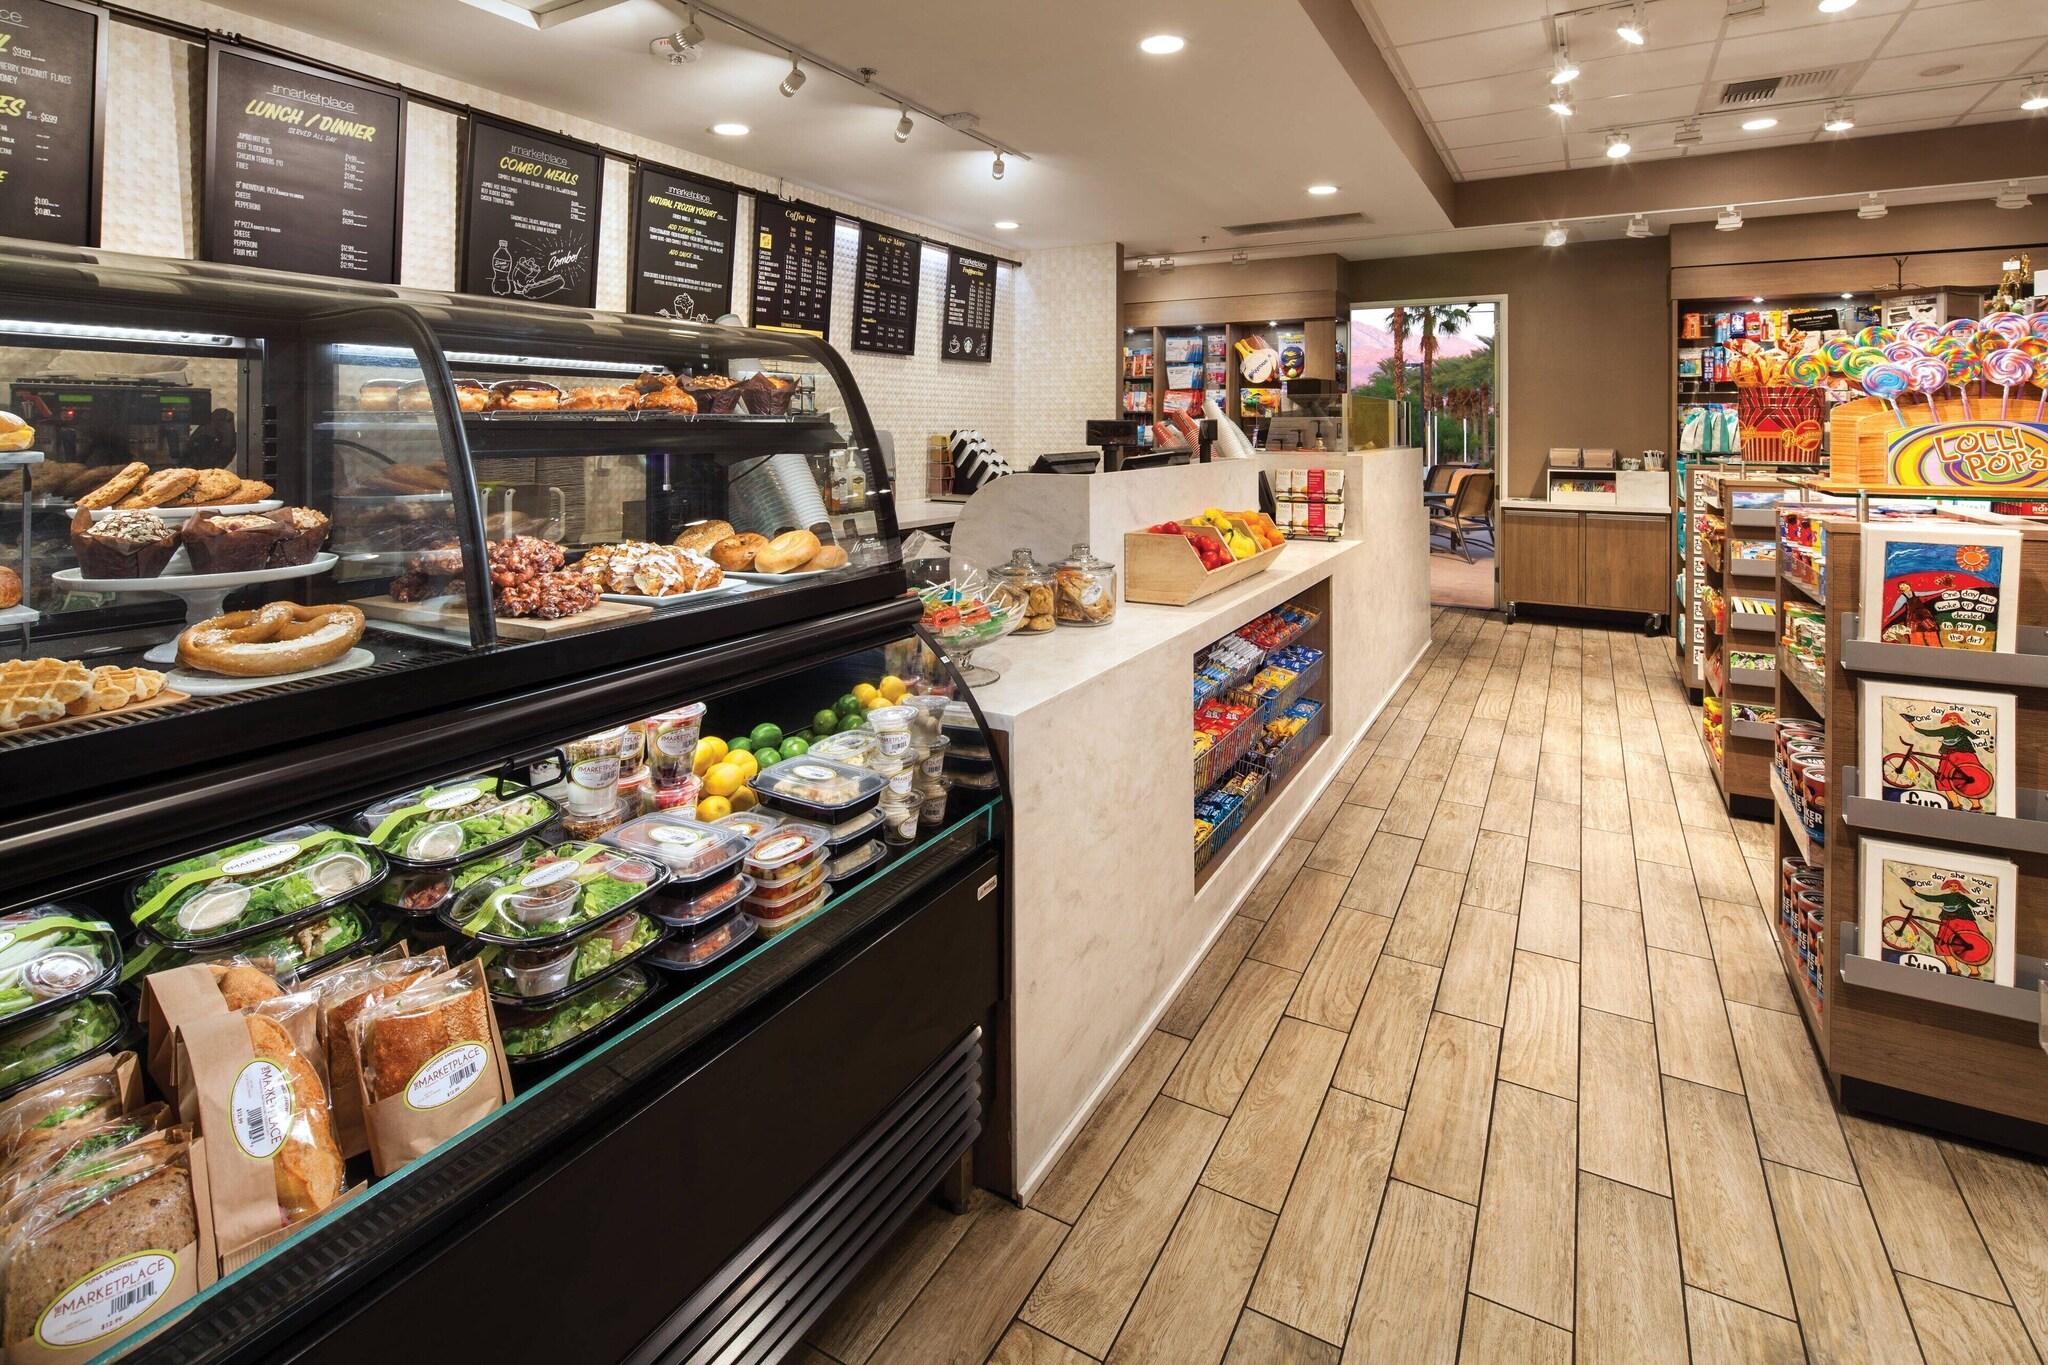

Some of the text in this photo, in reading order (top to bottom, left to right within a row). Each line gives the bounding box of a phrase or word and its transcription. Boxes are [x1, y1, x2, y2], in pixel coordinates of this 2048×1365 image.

[276, 85, 355, 111] marketplace
[245, 99, 304, 124] LUNCH
[319, 116, 376, 142] DINNER
[288, 127, 313, 138] SERVED
[325, 135, 338, 143] DAY
[513, 146, 568, 165] marketplace
[500, 156, 543, 176] COMBO
[543, 168, 579, 185] MEALS
[235, 191, 251, 199] CHEESE
[235, 200, 261, 211] PEPPERONI
[648, 194, 673, 208] NATURAL
[673, 201, 696, 213] FROZEN
[695, 207, 718, 218] YOGURT
[241, 221, 253, 229] PIZZA
[785, 210, 817, 224] Coffee Bar
[233, 229, 251, 238] CHEESE
[233, 239, 258, 248] PEPPERONI
[233, 248, 245, 256] FOUR
[547, 247, 582, 271] Combo!
[1934, 428, 2025, 463] LOLLI
[1964, 448, 2048, 480] POPS
[1962, 590, 1978, 598] day
[1937, 602, 1957, 610] woke
[1967, 636, 1983, 644] dirt
[1916, 714, 1932, 722] one
[1931, 706, 1946, 715] day
[1970, 709, 1992, 719] woke
[1970, 718, 1981, 726] up
[1932, 873, 1946, 881] day
[1950, 872, 1965, 880] she
[1971, 877, 1992, 889] woke
[1976, 897, 1990, 905] and
[418, 1046, 480, 1088] MARKETPLACE
[85, 1259, 139, 1287] TUNA SANDWICH
[61, 1258, 166, 1315] MARKETPLACE
[100, 1316, 123, 1330] $12.99
